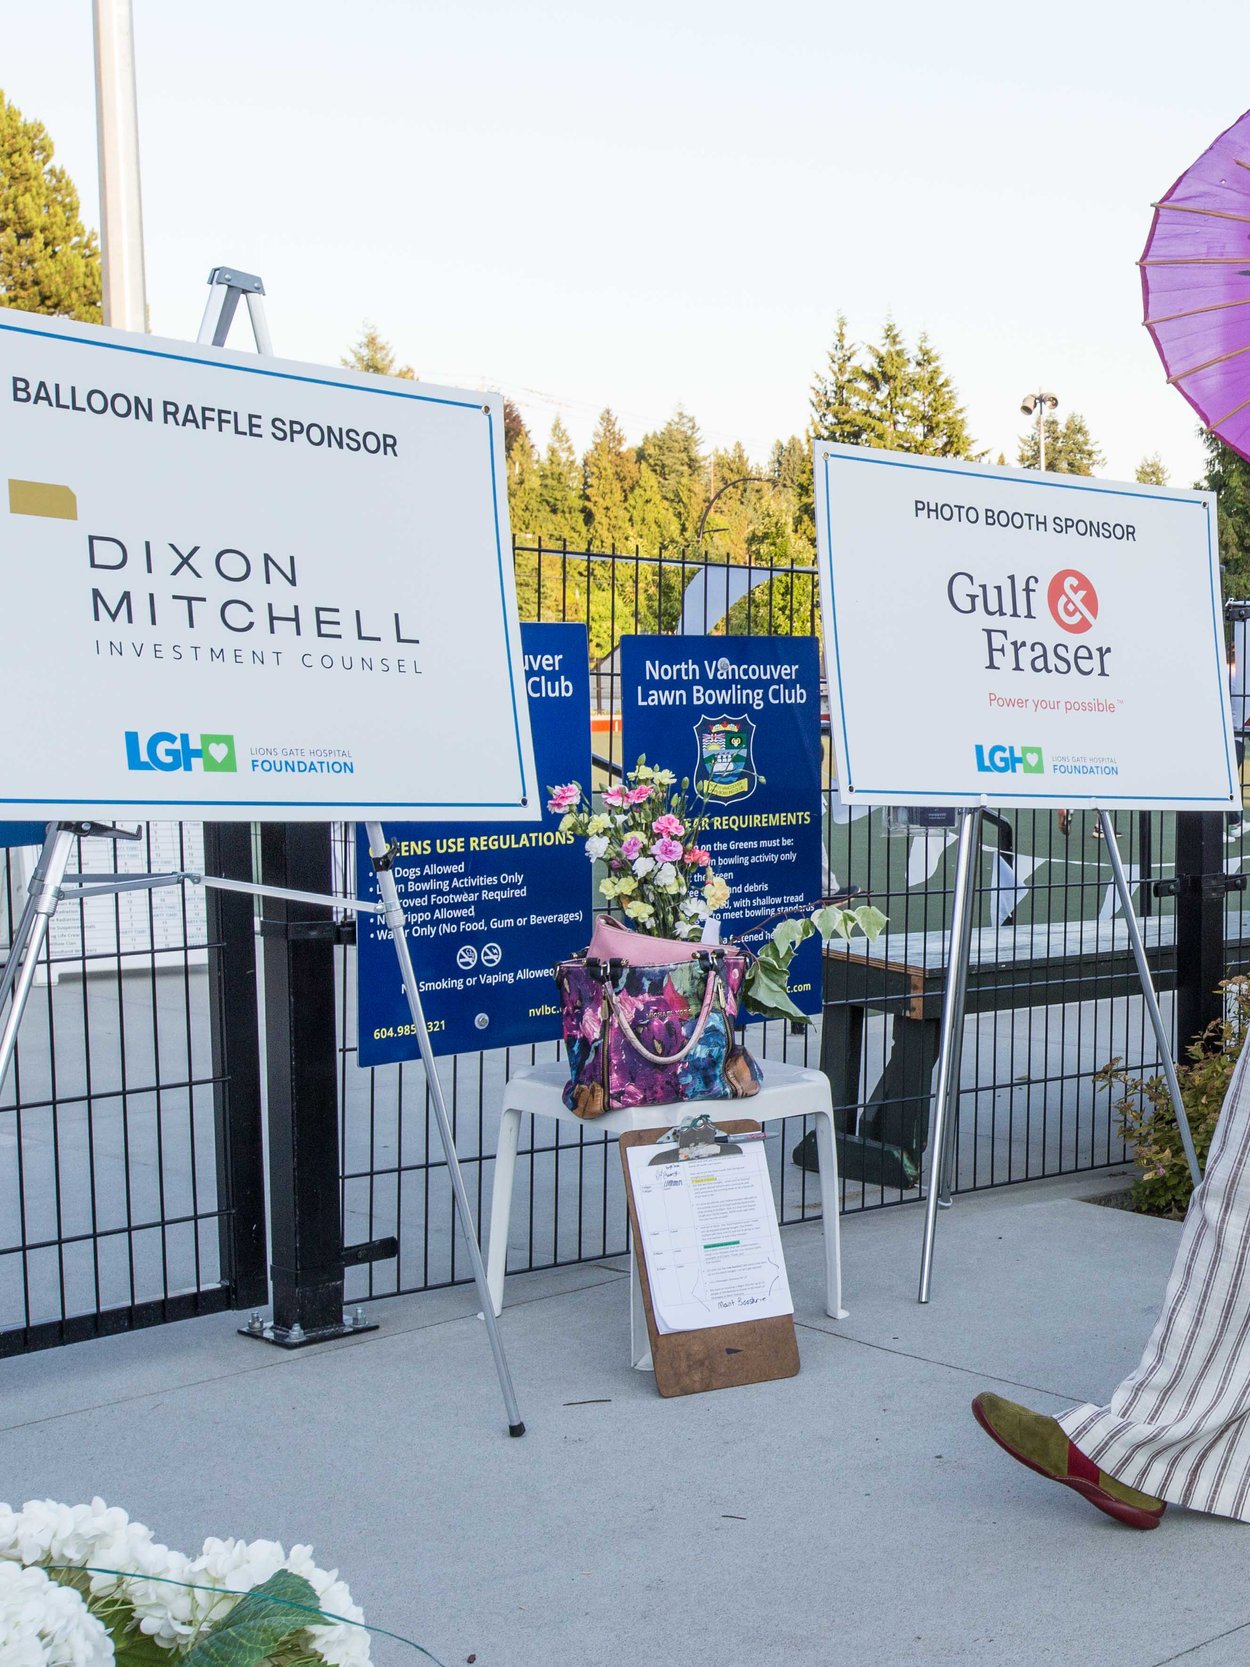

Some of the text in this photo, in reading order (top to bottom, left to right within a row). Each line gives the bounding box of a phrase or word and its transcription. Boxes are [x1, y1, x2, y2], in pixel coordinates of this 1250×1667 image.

[12, 376, 398, 457] BALLOON RAFFLE SPONSOR
[914, 500, 1136, 542] PHOTO BOOTH SPONSOR
[87, 534, 298, 588] DIXON
[947, 571, 1039, 619] Gulf
[91, 587, 420, 645] MITCHELL
[95, 639, 423, 675] INVESTMENT COUNSEL
[982, 628, 1111, 677] Fraser
[645, 660, 799, 681] North Vancouver
[527, 676, 573, 698] Club
[637, 685, 807, 709] Lawn Bowling Club
[988, 692, 1030, 708] Power
[1032, 698, 1061, 712] your
[1065, 697, 1116, 714] possible
[125, 731, 203, 772] LGH
[250, 748, 352, 758] LIONS GATE HOSPITAL
[975, 744, 1024, 774] LGH
[251, 759, 354, 774] FOUNDATION
[1053, 765, 1119, 775] FOUNDATION
[713, 811, 811, 831] REQUIREMENTS
[436, 838, 465, 854] USE
[470, 830, 575, 851] REGULATIONS
[701, 843, 711, 852] on
[714, 841, 728, 851] the
[729, 840, 758, 850] Greens
[760, 838, 780, 848] must
[782, 837, 794, 846] be:
[718, 855, 750, 866] bowling
[751, 852, 779, 863] activity
[780, 851, 797, 862] only
[395, 867, 421, 879] Dogs
[423, 861, 465, 876] Allowed
[408, 878, 449, 892] Bowling
[452, 874, 498, 889] Activities
[500, 872, 524, 885] Only
[745, 882, 769, 893] debris
[431, 891, 479, 906] Footwear
[482, 886, 527, 902] Required
[733, 898, 751, 908] with
[752, 894, 782, 906] shallow
[783, 892, 804, 903] tread
[434, 905, 475, 920] Allowed
[722, 910, 743, 919] meet
[745, 907, 776, 918] bowling
[377, 910, 583, 941] War Only (No Food, Gum or Beverages)
[419, 977, 464, 993] Smoking
[466, 976, 478, 987] or
[479, 971, 514, 987] Vaping
